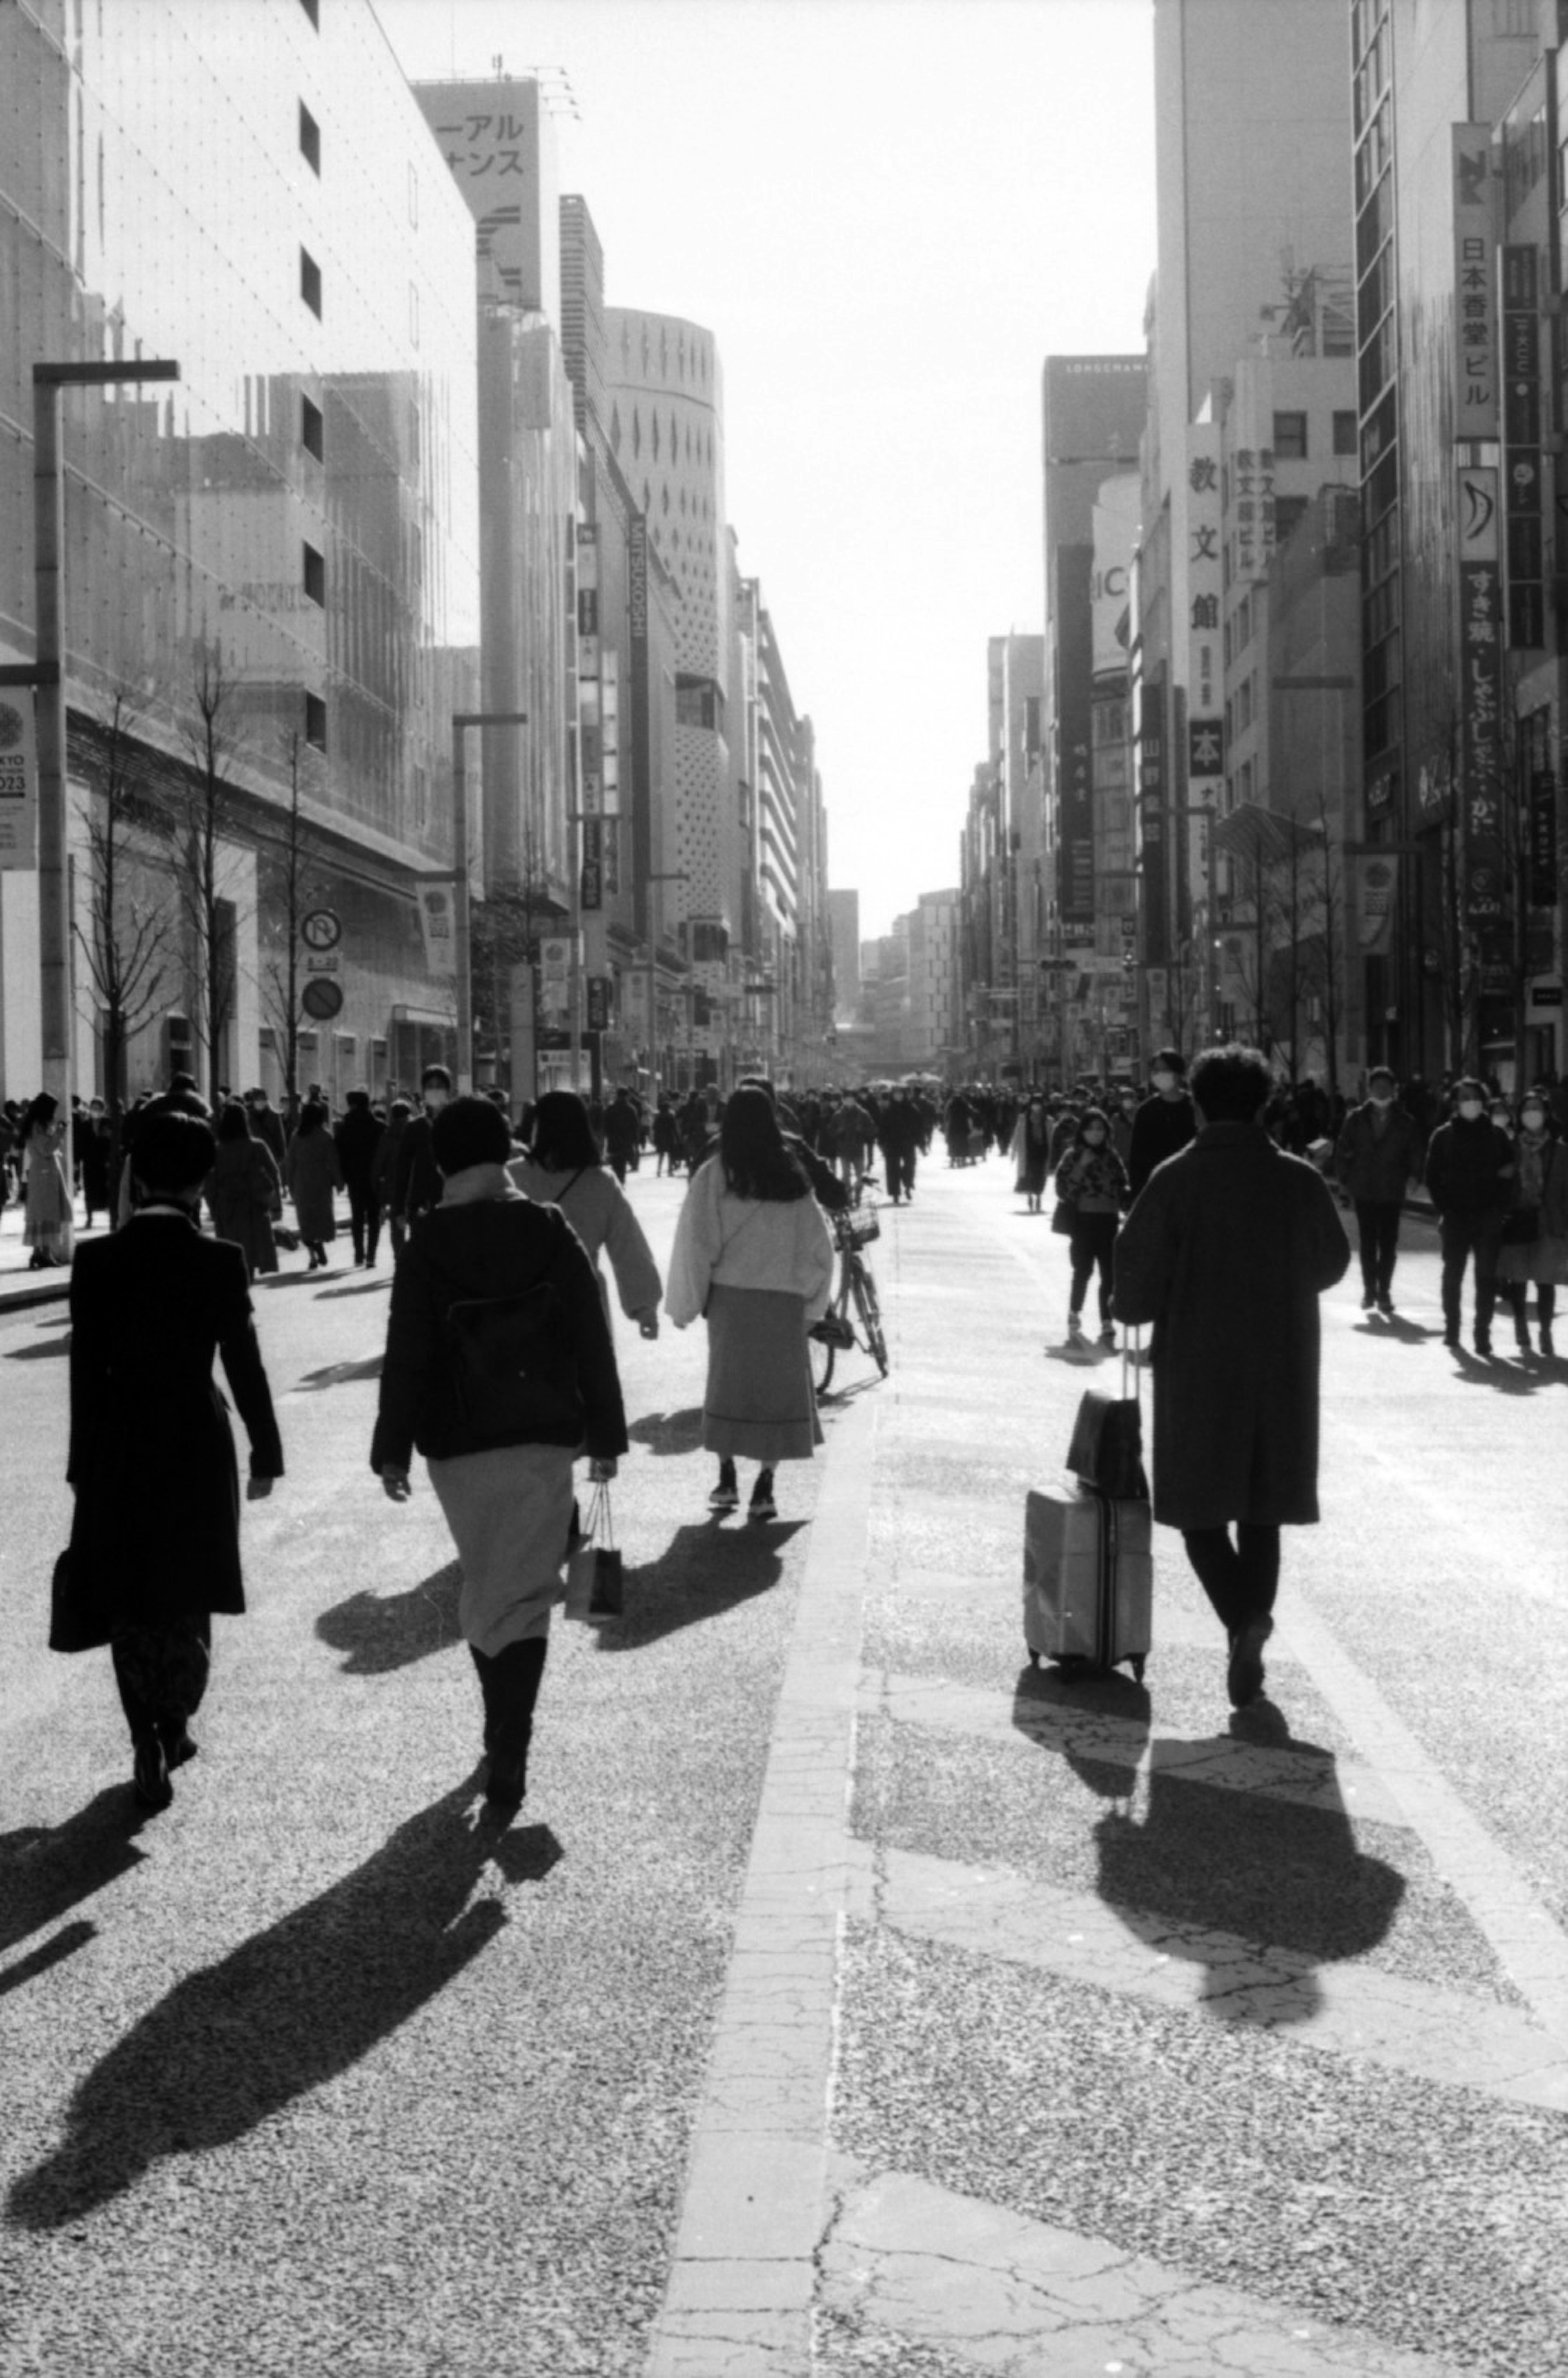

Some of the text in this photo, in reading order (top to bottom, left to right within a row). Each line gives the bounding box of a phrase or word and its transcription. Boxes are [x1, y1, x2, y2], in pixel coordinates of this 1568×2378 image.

[436, 114, 523, 141] ーアル
[445, 150, 523, 176] ナンス
[1461, 237, 1491, 406] 日本香堂ビル
[630, 520, 646, 638] MITSUKOSHI
